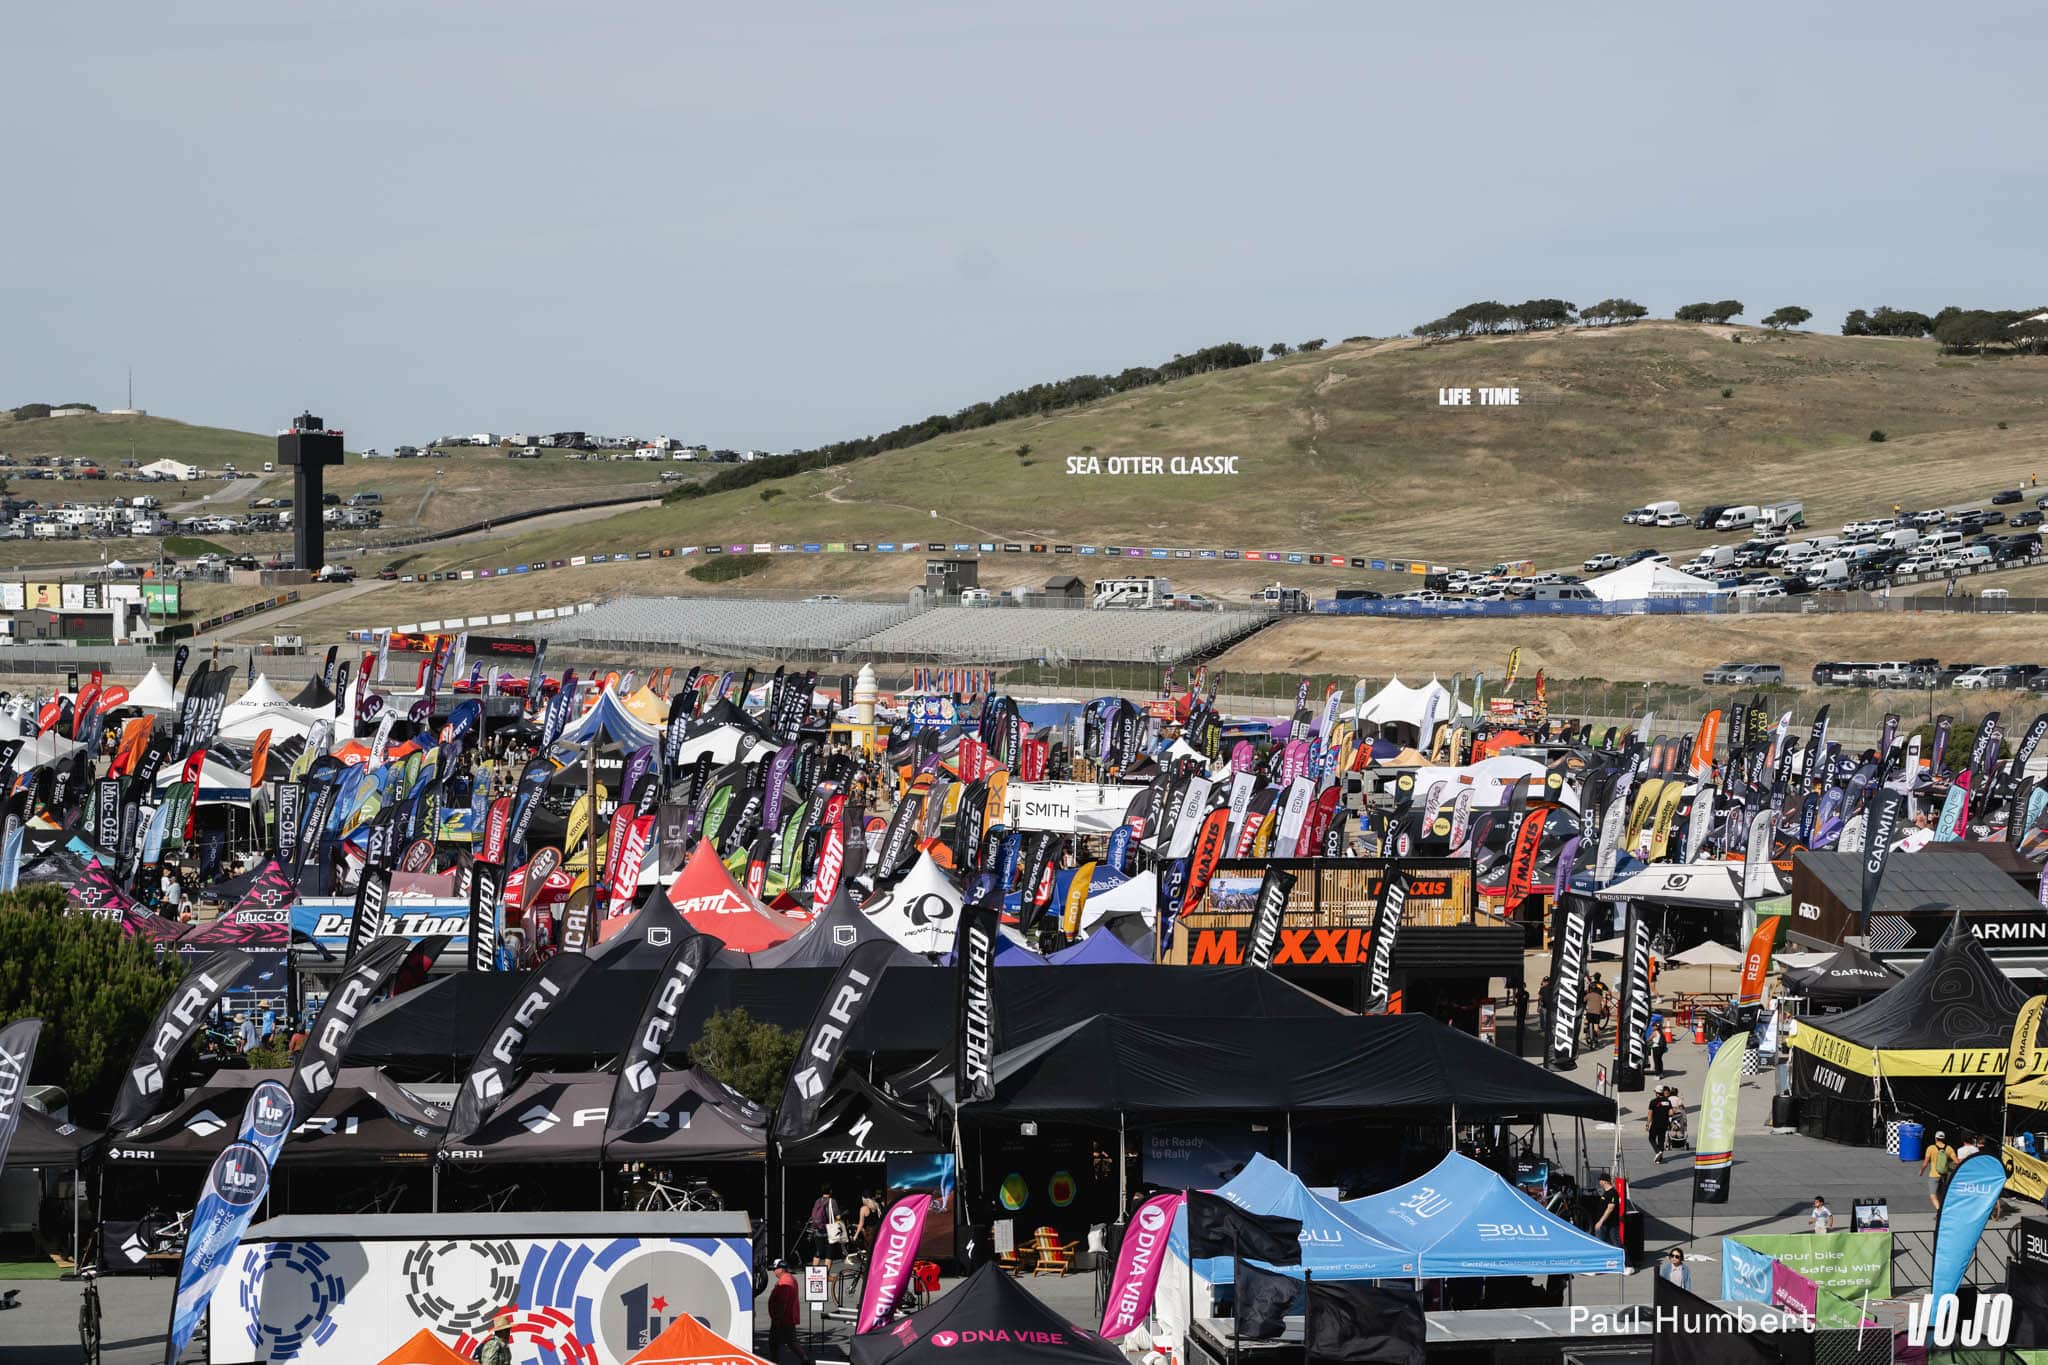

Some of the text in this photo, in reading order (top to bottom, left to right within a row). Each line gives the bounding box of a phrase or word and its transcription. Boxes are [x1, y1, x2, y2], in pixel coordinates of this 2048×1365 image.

[1439, 387, 1520, 406] LIFE TIME
[1066, 456, 1239, 475] SEA OTTER CLASSIC
[338, 670, 346, 713] CADEX
[362, 701, 381, 722] Liv
[410, 706, 431, 723] Liv
[1007, 715, 1018, 772] CHROMAPOP
[1118, 718, 1132, 777] CHROMAPOP
[103, 785, 117, 844] Muc-Off
[282, 786, 296, 847] Muc-Off
[303, 826, 315, 844] BIKE
[309, 807, 322, 828] SHOP
[317, 785, 331, 808] TOOLS
[512, 827, 525, 845] BIKE
[519, 808, 533, 829] SHOP
[528, 786, 543, 809] TOOLS
[808, 797, 824, 826] SRAM
[1025, 801, 1070, 818] SMITH
[1170, 790, 1184, 821] LAKE
[2016, 796, 2025, 823] HUNT
[490, 806, 503, 852] ENERVIT
[878, 799, 917, 878] SRAM POWER
[1517, 821, 1539, 880] MAXXIS
[1867, 799, 1899, 874] GARMIN
[407, 842, 426, 872] mrp
[531, 850, 554, 880] mrp
[614, 824, 645, 900] LEATT
[816, 827, 844, 902] LEATT
[1197, 821, 1219, 883] MAXXIS
[314, 913, 400, 938] Pak
[1370, 883, 1406, 1003] SPECIALIZED
[1552, 911, 1586, 1058] SPECIALIZED
[1747, 953, 1761, 981] RED
[1831, 967, 1888, 978] GARMIN
[317, 964, 382, 1057] ARI
[642, 959, 695, 1055] ARI
[811, 968, 871, 1063] ARI
[965, 927, 991, 1086] SPECIALIZED
[1628, 918, 1651, 1070] SPECIALIZED
[152, 972, 220, 1061] ARI
[492, 976, 561, 1065] ARI
[2019, 1008, 2034, 1056] MAGURA
[1810, 1033, 1853, 1067] AVENTON
[1813, 1064, 1848, 1095] AVENTON
[1708, 1081, 1725, 1139] MOSS
[122, 1150, 155, 1159] ARI
[450, 1149, 483, 1159] ARI
[1151, 1136, 1205, 1150] Get Ready
[1151, 1148, 1192, 1161] to Rally
[2014, 1165, 2043, 1184] MAGURA
[881, 1234, 908, 1279] DNA
[1130, 1239, 1156, 1281] DNA
[1773, 1251, 1844, 1262] your bike
[1799, 1263, 1881, 1275] safely with
[962, 1328, 1011, 1344] DNA
